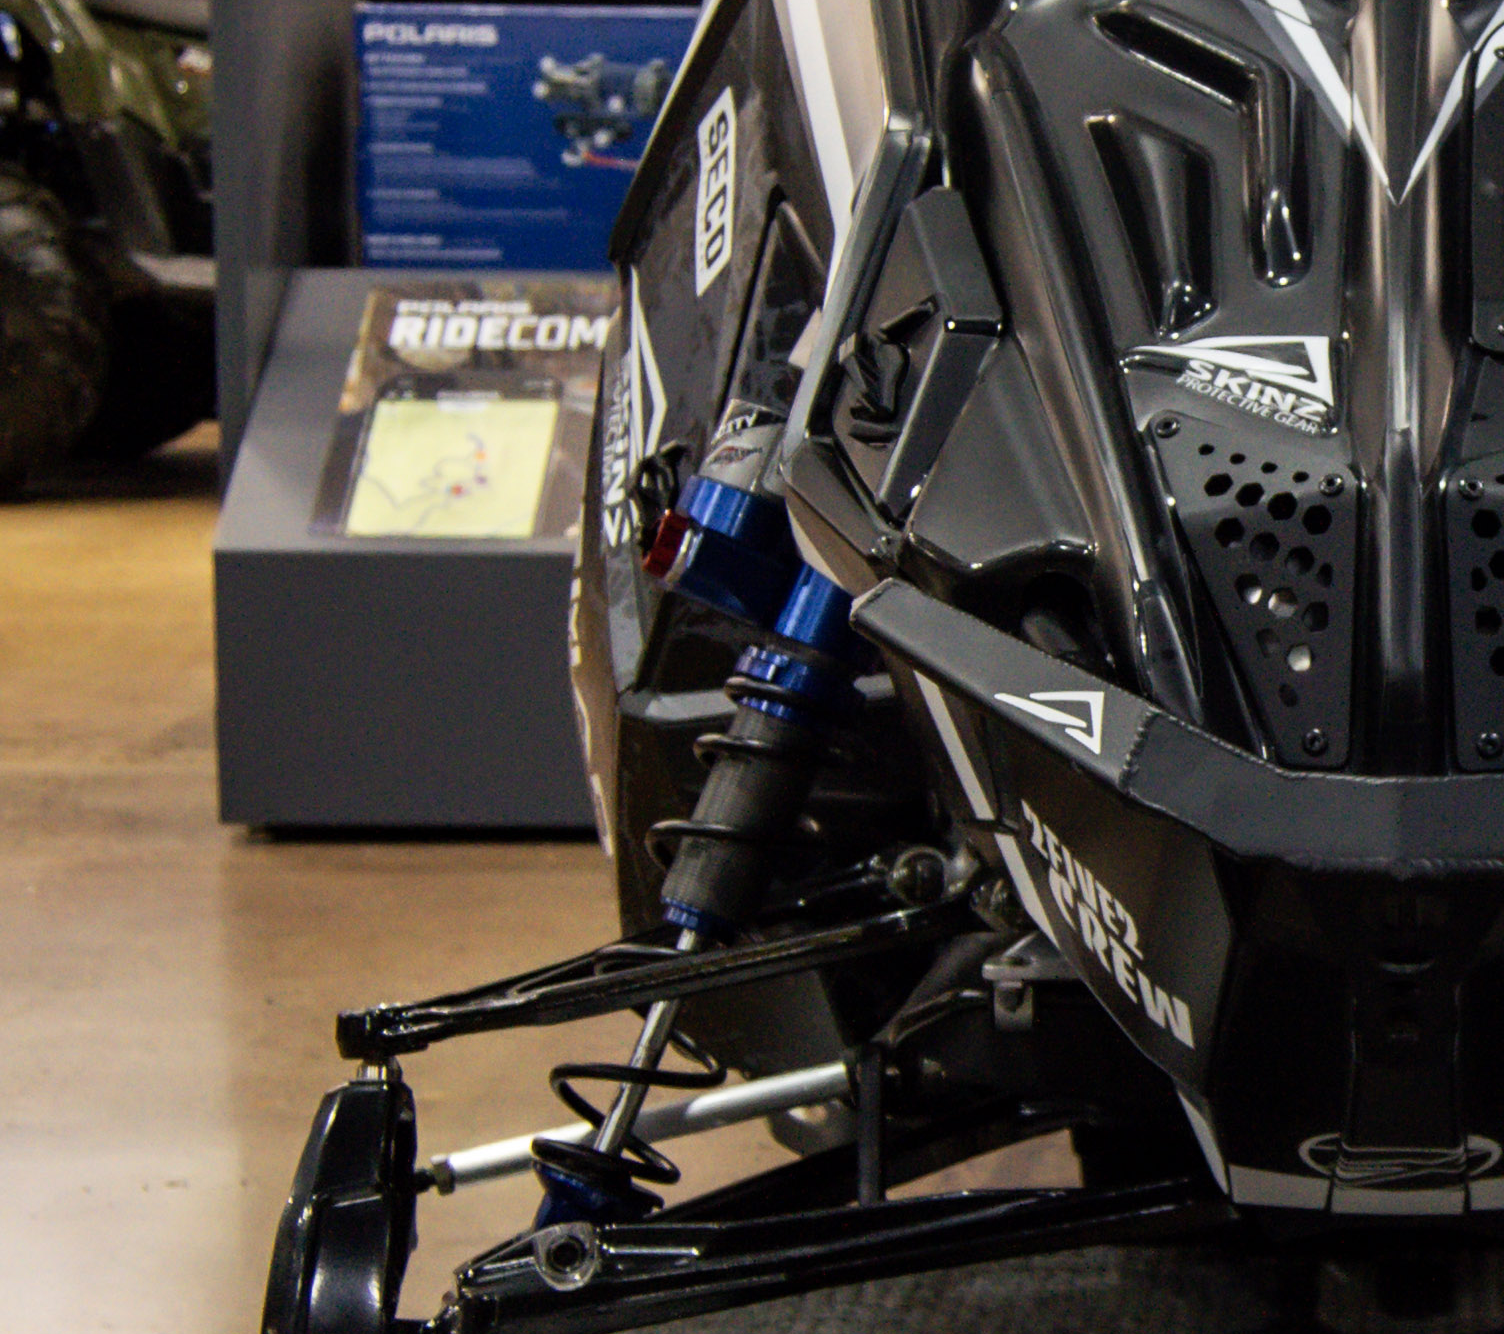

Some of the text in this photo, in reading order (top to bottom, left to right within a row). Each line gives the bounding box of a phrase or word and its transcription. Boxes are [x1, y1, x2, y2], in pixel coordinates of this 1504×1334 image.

[362, 22, 500, 47] POLARIS
[704, 109, 731, 270] SECO
[1176, 373, 1273, 418] PROTECTIVE
[1184, 358, 1329, 424] SKINZ
[1048, 866, 1196, 1050] CREW
